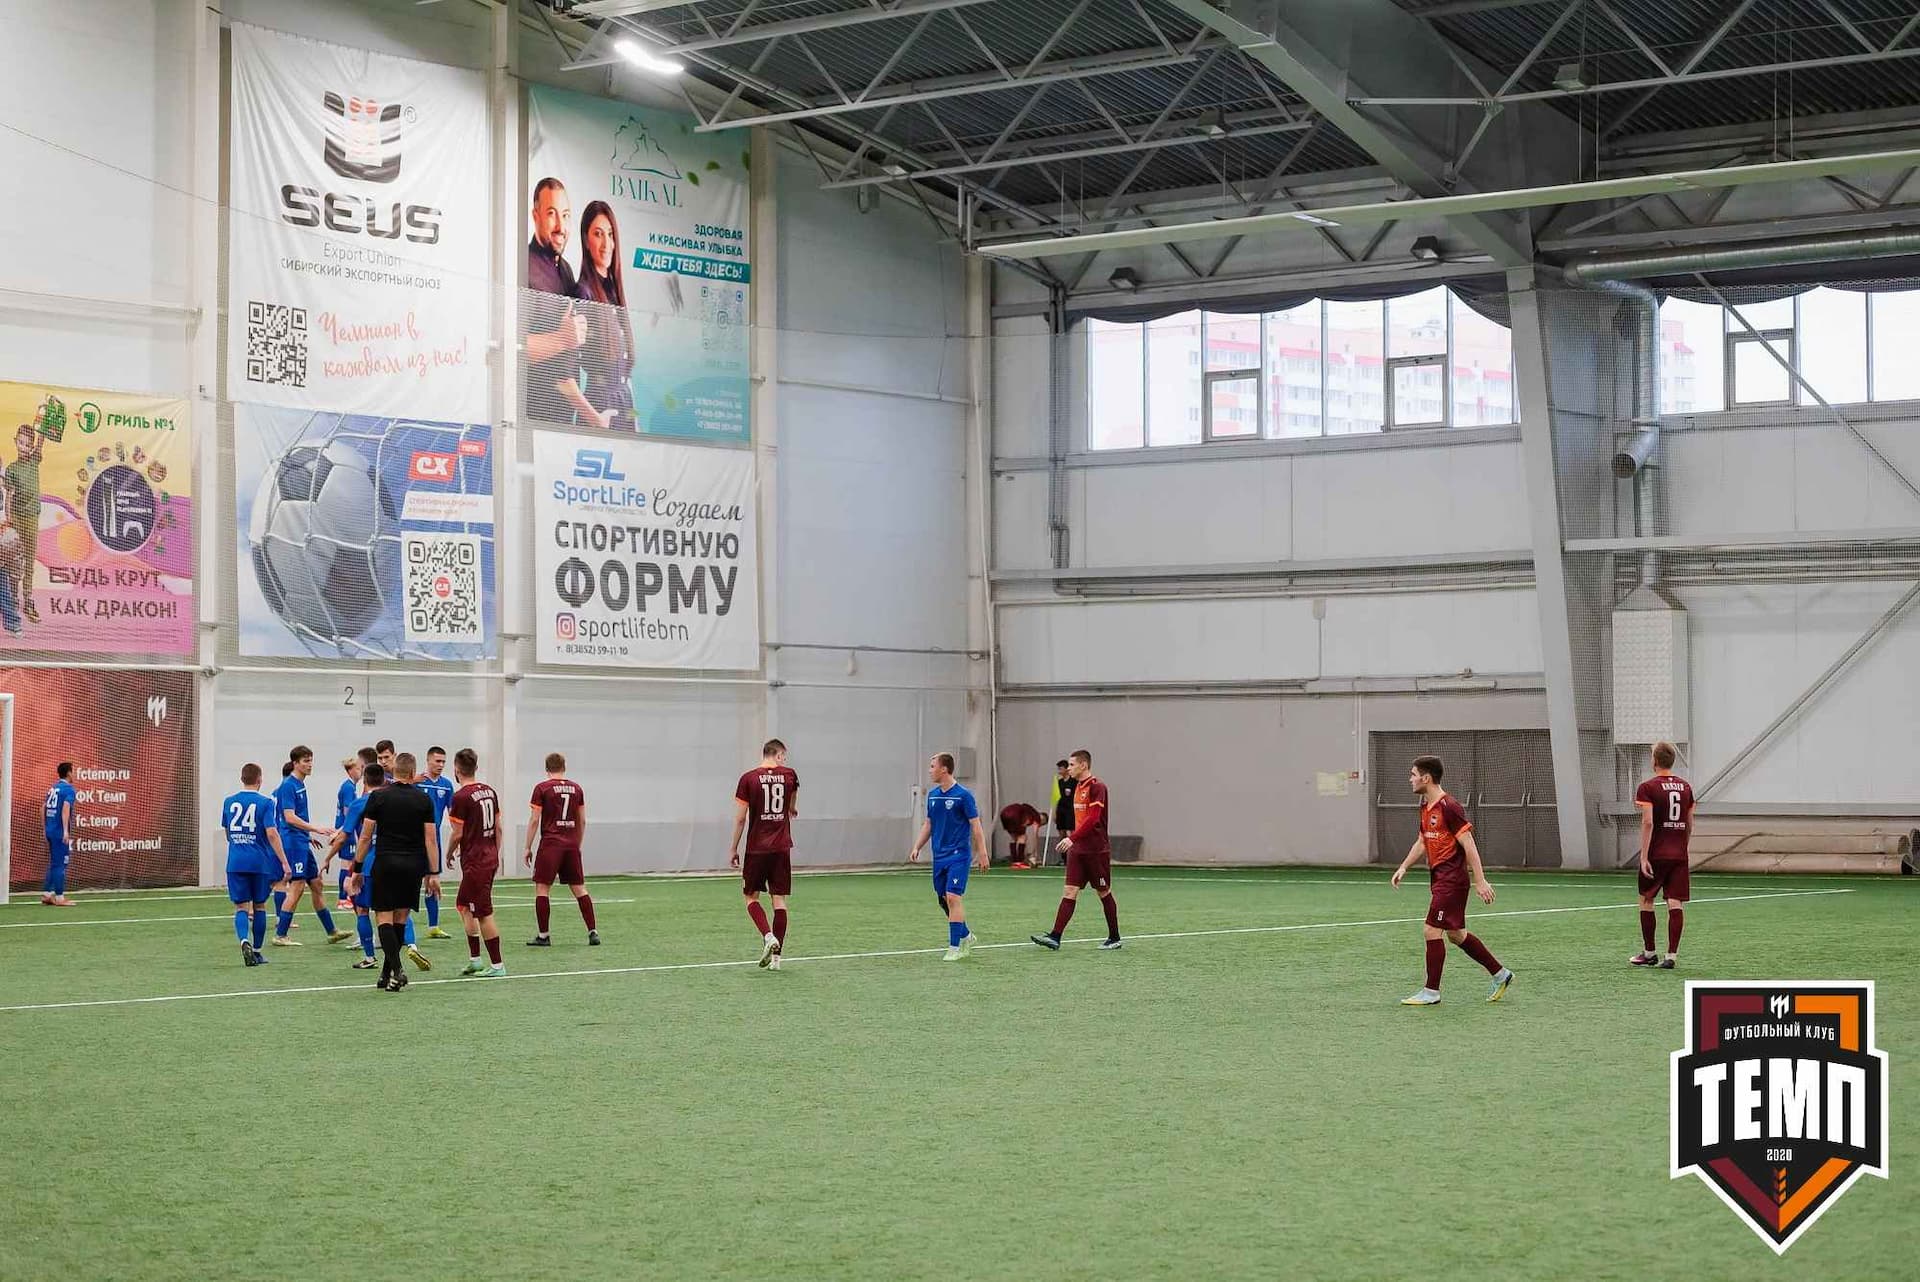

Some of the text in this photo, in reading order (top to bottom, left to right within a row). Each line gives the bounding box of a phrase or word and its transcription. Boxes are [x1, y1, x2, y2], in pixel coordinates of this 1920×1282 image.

[611, 175, 682, 208] BAIKAL
[281, 184, 442, 245] SEUS
[649, 234, 743, 257] И КРАСИВАЯ УЛЫБКА
[694, 224, 743, 241] ЗДОРОВАЯ
[323, 243, 400, 266] Export Union
[641, 254, 743, 280] ЖДЕТ ТЕБЯ ЗДЕСЬ!
[281, 258, 342, 278] СИБИРСКИЙ
[344, 266, 412, 288] ЭКСПОРТНЫЙ
[107, 413, 176, 431] ГРИЛЬ №1
[573, 449, 626, 482] SL
[653, 488, 744, 528] Создаем
[554, 519, 740, 560] СПОРТИВНУЮ
[49, 566, 167, 592] БУДЬ КРУТ,
[554, 556, 738, 617] ФОРМУ
[50, 597, 177, 620] КАК ДРАКОН!
[578, 616, 689, 642] sportlifebrn
[344, 686, 354, 706] 2
[76, 767, 130, 783] fctemp.ru
[76, 789, 126, 803] ФК Темп
[560, 794, 570, 820] 7
[762, 783, 785, 813] 18
[1669, 791, 1681, 821] 6
[75, 815, 119, 830] fc.temp
[229, 802, 257, 832] 24
[479, 798, 495, 830] 10
[76, 836, 162, 853] fctemp_barnaul
[294, 862, 304, 874] 12
